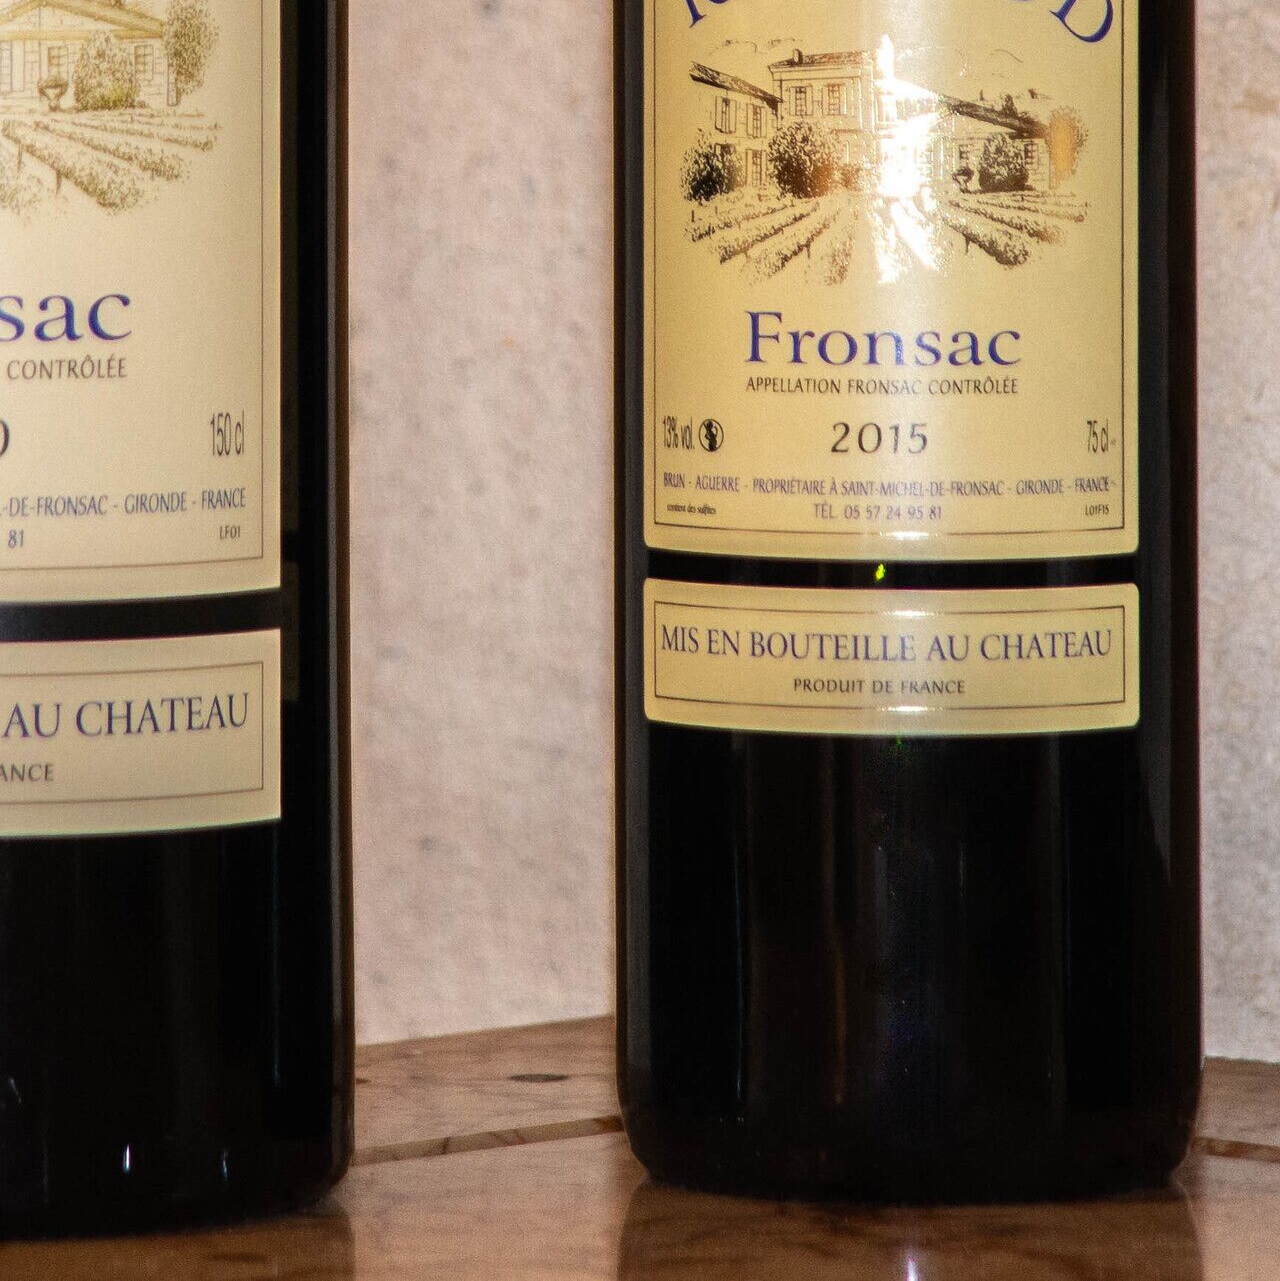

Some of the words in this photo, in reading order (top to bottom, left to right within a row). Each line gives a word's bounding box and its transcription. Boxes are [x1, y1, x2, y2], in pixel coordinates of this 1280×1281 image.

[745, 311, 1021, 366] Fronsac
[6, 355, 128, 380] CONTRÔLÉE
[746, 377, 841, 394] APPELLATION
[848, 378, 922, 395] FRONSAC
[928, 376, 1018, 395] CONTRÔLÉE
[210, 413, 231, 456] 150
[235, 410, 244, 455] cl
[831, 422, 928, 454] 2015
[1087, 420, 1098, 453] 75
[664, 472, 685, 488] BRUN
[696, 476, 740, 492] AGUERRE
[753, 476, 824, 495] PROPRIÉTAIRE
[829, 477, 838, 495] À
[1016, 479, 1064, 495] GIRONDE
[1075, 477, 1108, 493] FRANCE
[125, 492, 187, 514] GIRONDE
[202, 488, 245, 509] FRANCE
[844, 504, 859, 519] 05
[866, 505, 880, 519] 57
[886, 505, 900, 519] 24
[8, 529, 24, 548] 81
[661, 625, 699, 653] MIS
[707, 629, 740, 656] EN
[750, 631, 916, 662] BOUTEILLE
[926, 634, 970, 661] AU
[979, 629, 1112, 661] CHATEAU
[793, 678, 864, 694] PRODUIT
[872, 678, 892, 694] DE
[900, 678, 965, 694] FRANCE
[1, 702, 61, 739] AU
[75, 692, 249, 736] CHATEAU
